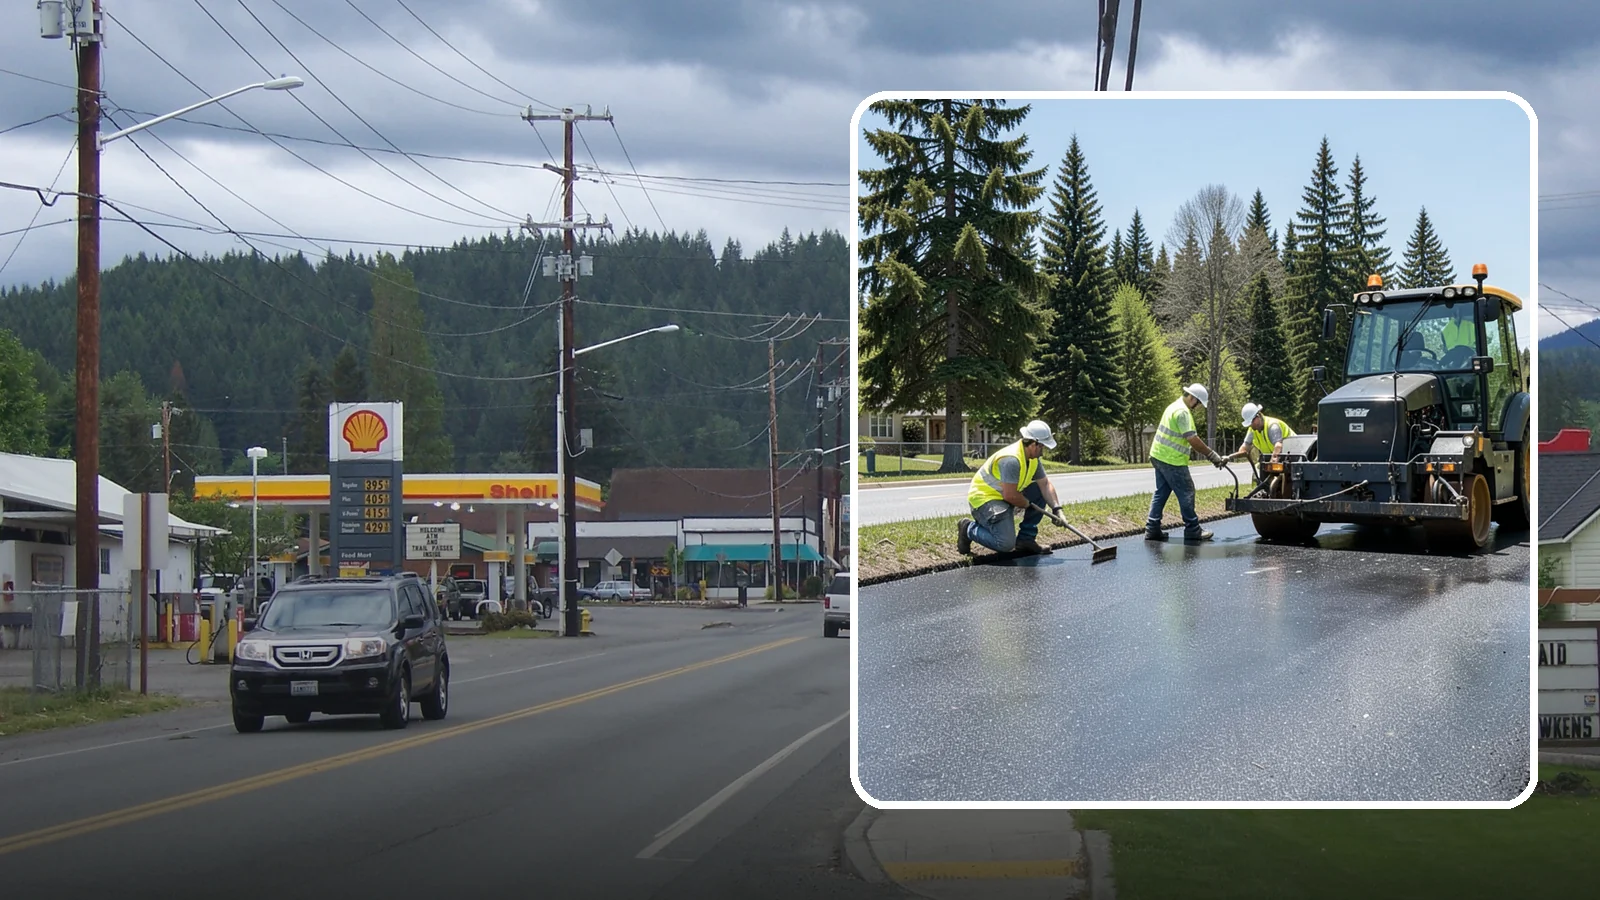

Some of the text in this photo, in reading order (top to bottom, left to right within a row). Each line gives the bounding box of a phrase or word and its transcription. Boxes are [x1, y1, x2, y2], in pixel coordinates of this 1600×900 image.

[366, 480, 383, 490] 395
[490, 484, 547, 498] Shell
[366, 494, 383, 504] 405
[366, 508, 383, 518] 415
[366, 522, 383, 532] 429
[1539, 643, 1566, 665] AID
